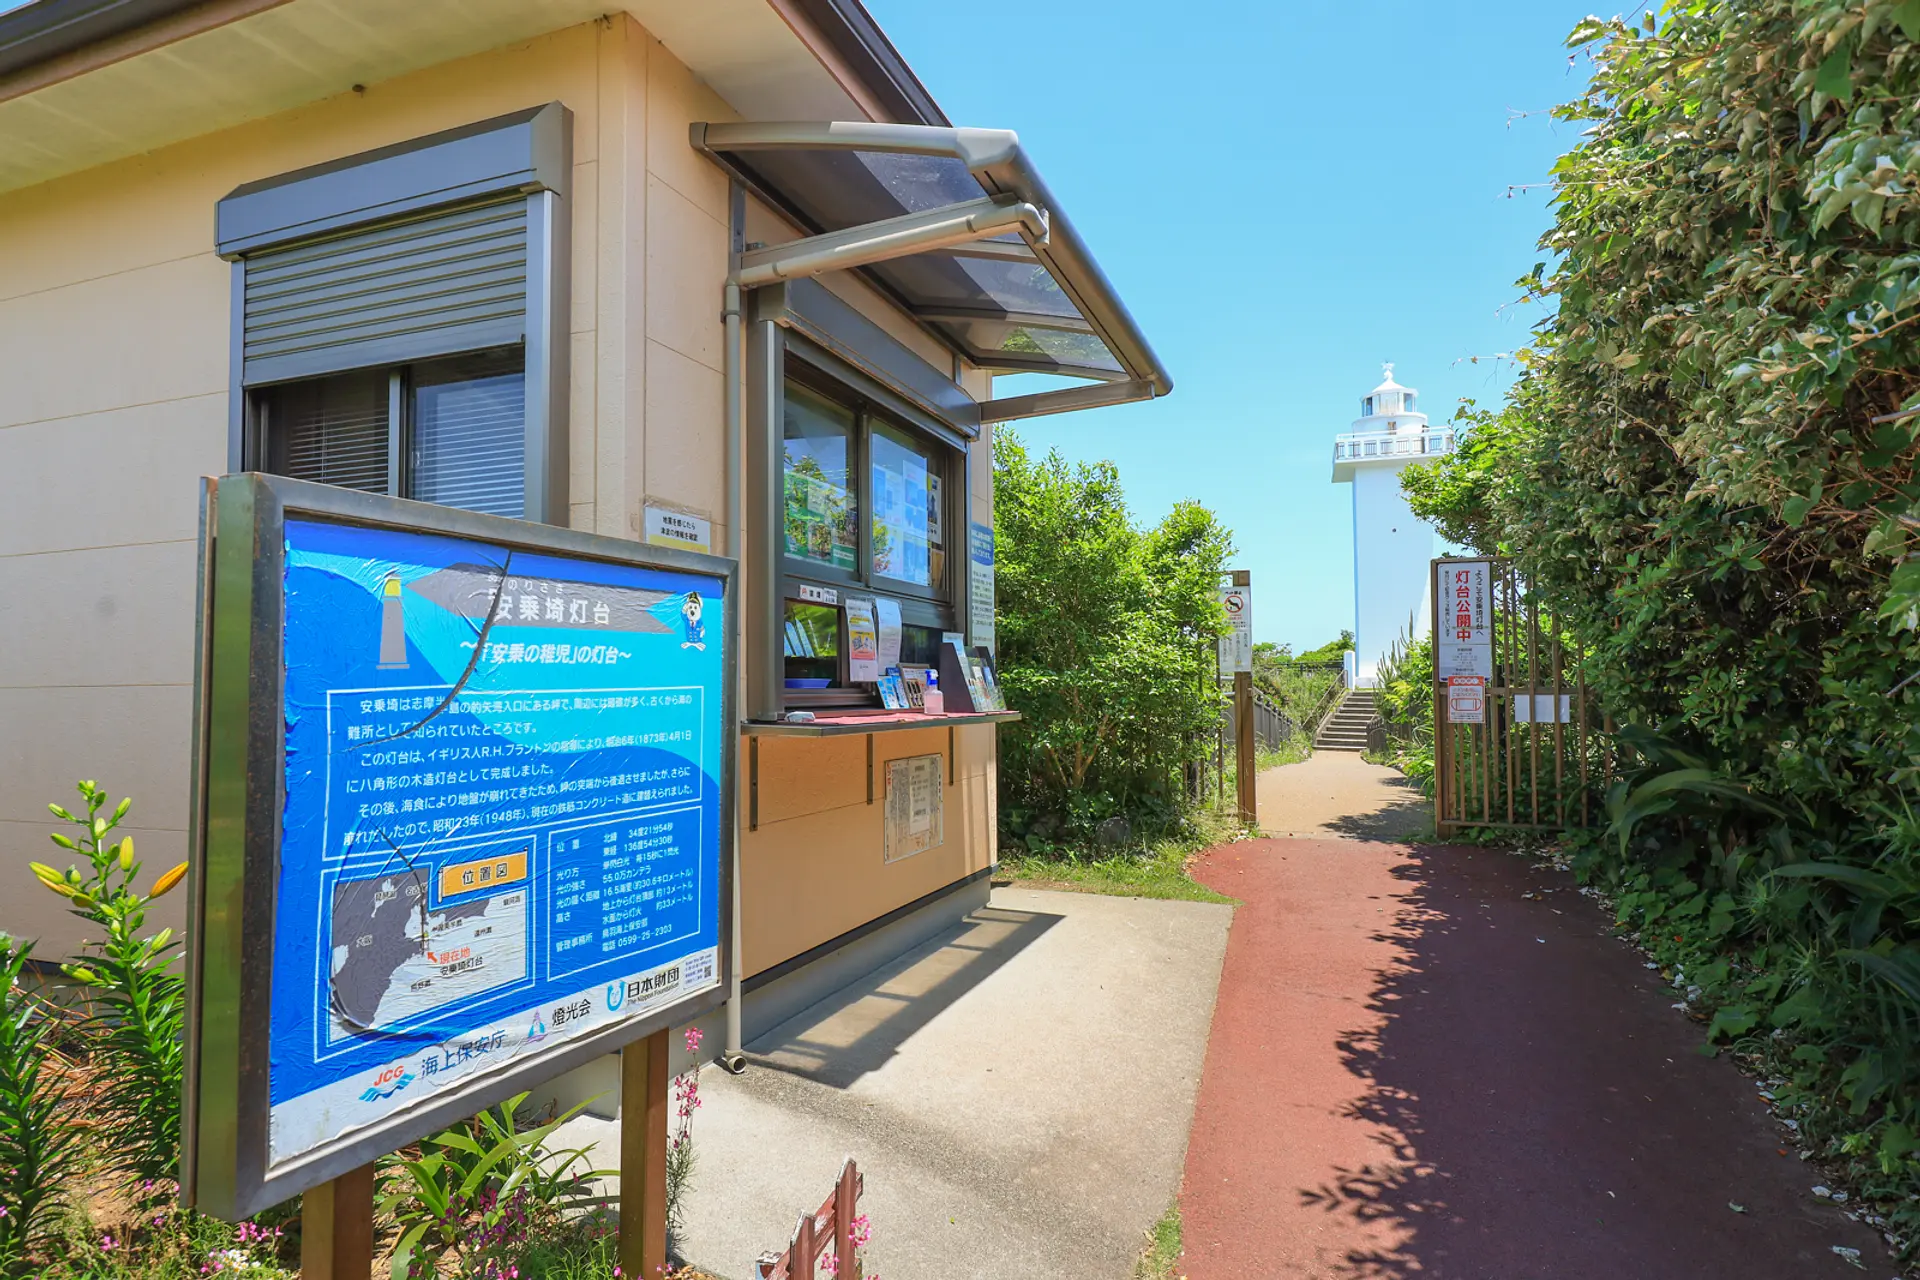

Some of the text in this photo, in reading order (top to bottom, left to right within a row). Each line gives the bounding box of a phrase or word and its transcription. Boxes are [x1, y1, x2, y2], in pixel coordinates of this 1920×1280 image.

[489, 589, 612, 625] 安乗埼灯台
[1455, 570, 1472, 643] 灯台公開中
[346, 764, 553, 793] に八角形の木造灯台として完成しました。
[463, 862, 508, 884] 位置図
[440, 947, 471, 964] 現在地
[628, 967, 680, 998] 日本財団
[552, 998, 591, 1027] 燈光会
[421, 1029, 506, 1077] 海上保安庁
[373, 1065, 405, 1087] JCG
